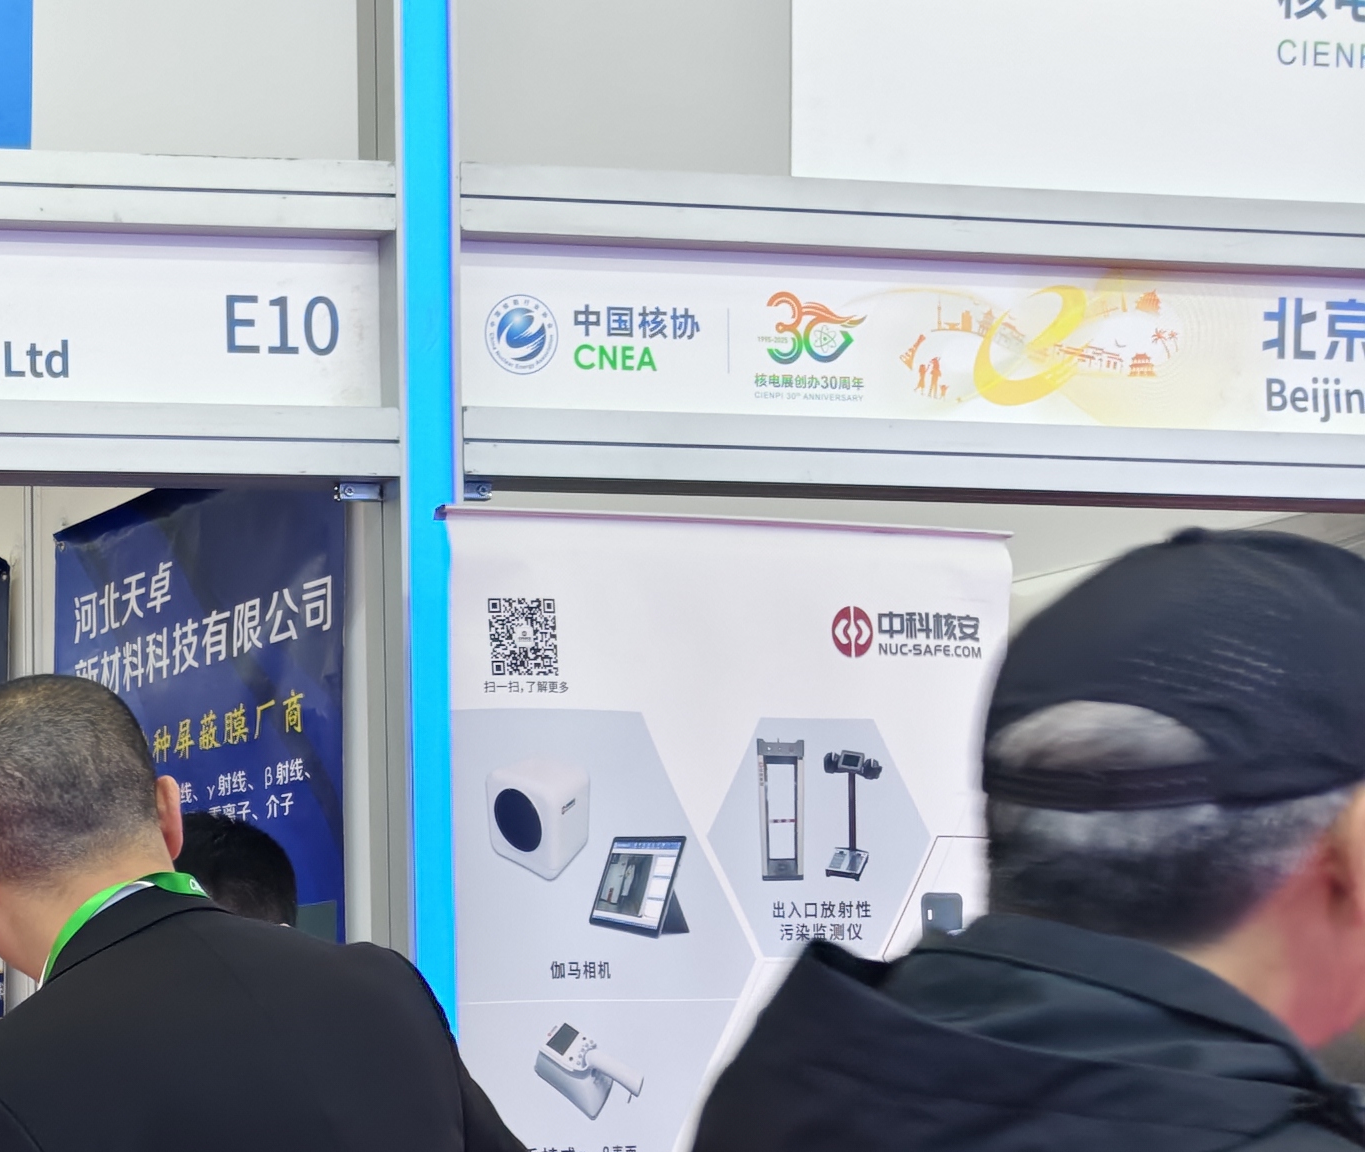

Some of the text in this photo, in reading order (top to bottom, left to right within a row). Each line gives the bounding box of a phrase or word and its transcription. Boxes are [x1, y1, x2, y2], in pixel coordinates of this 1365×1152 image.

[225, 293, 341, 356] E10
[573, 304, 701, 341] 中国核协
[2, 339, 71, 380] Ltd
[573, 343, 657, 373] CNEA
[754, 373, 865, 391] 核电展创办30周年
[73, 560, 173, 644] 河北天卓
[877, 610, 982, 643] 中科核安
[877, 642, 983, 659] NUC-SAFE.COM
[771, 900, 872, 920] 出入口放射性
[779, 922, 863, 941] 污染监测仪
[549, 960, 612, 980] 伽马相机
